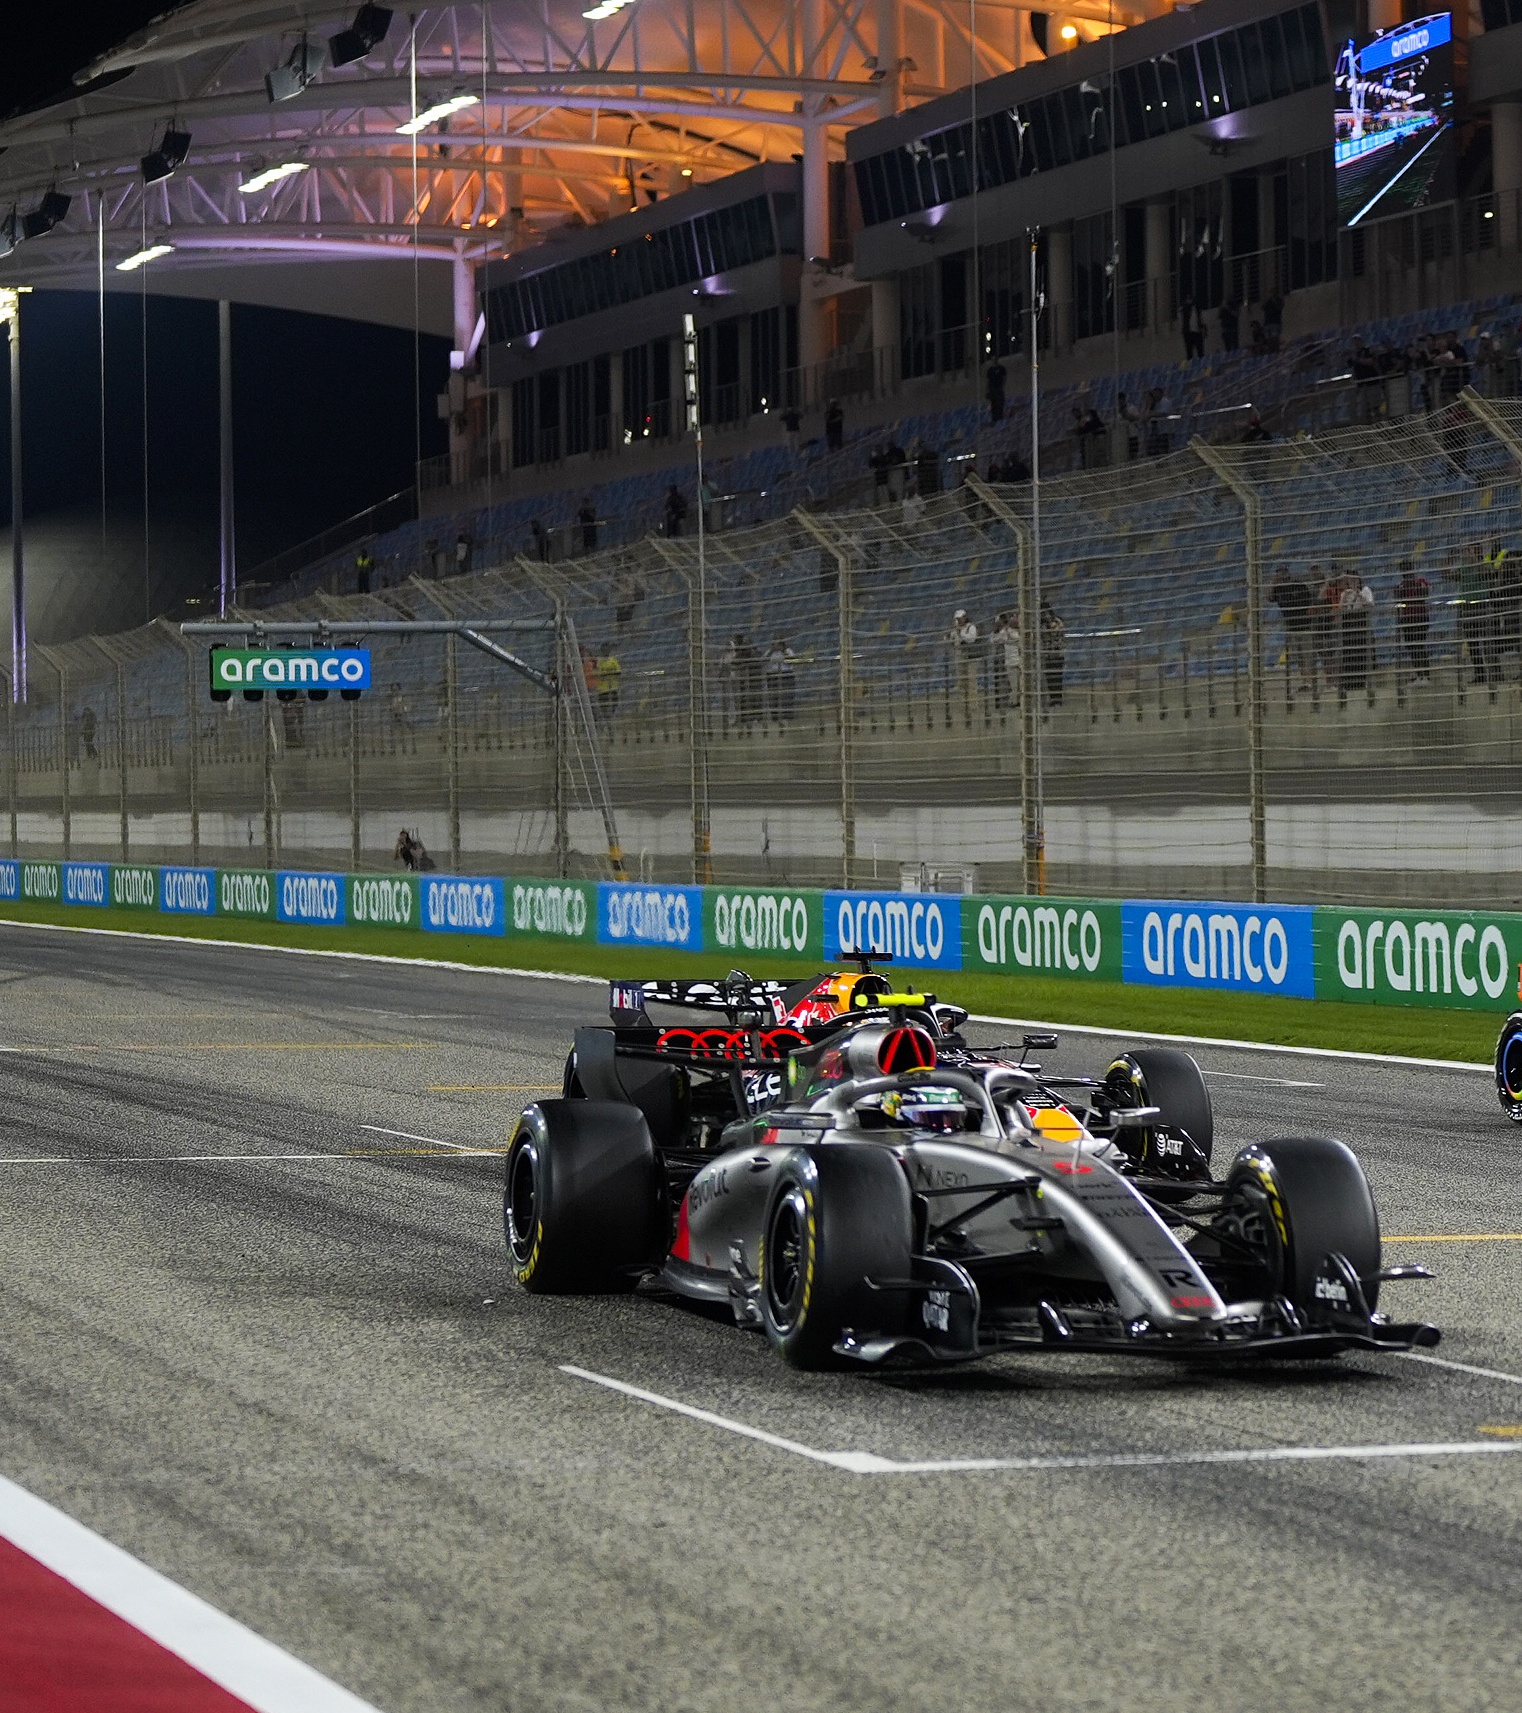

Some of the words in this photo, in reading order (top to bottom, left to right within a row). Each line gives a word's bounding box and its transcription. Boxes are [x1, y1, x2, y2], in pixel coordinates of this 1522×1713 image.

[220, 658, 364, 682] aramco
[24, 865, 58, 898] aramco
[67, 867, 104, 903] aramco
[114, 868, 154, 906] aramco
[165, 871, 209, 911] aramco
[222, 873, 269, 913] aramco
[283, 877, 338, 919] aramco
[353, 879, 412, 923] aramco
[428, 882, 494, 927] aramco
[512, 884, 587, 937] aramco
[608, 889, 691, 943] aramco
[713, 894, 808, 952] aramco
[838, 899, 944, 961] aramco
[978, 904, 1101, 972] aramco
[1143, 911, 1288, 985] aramco
[1337, 919, 1509, 999] aramco
